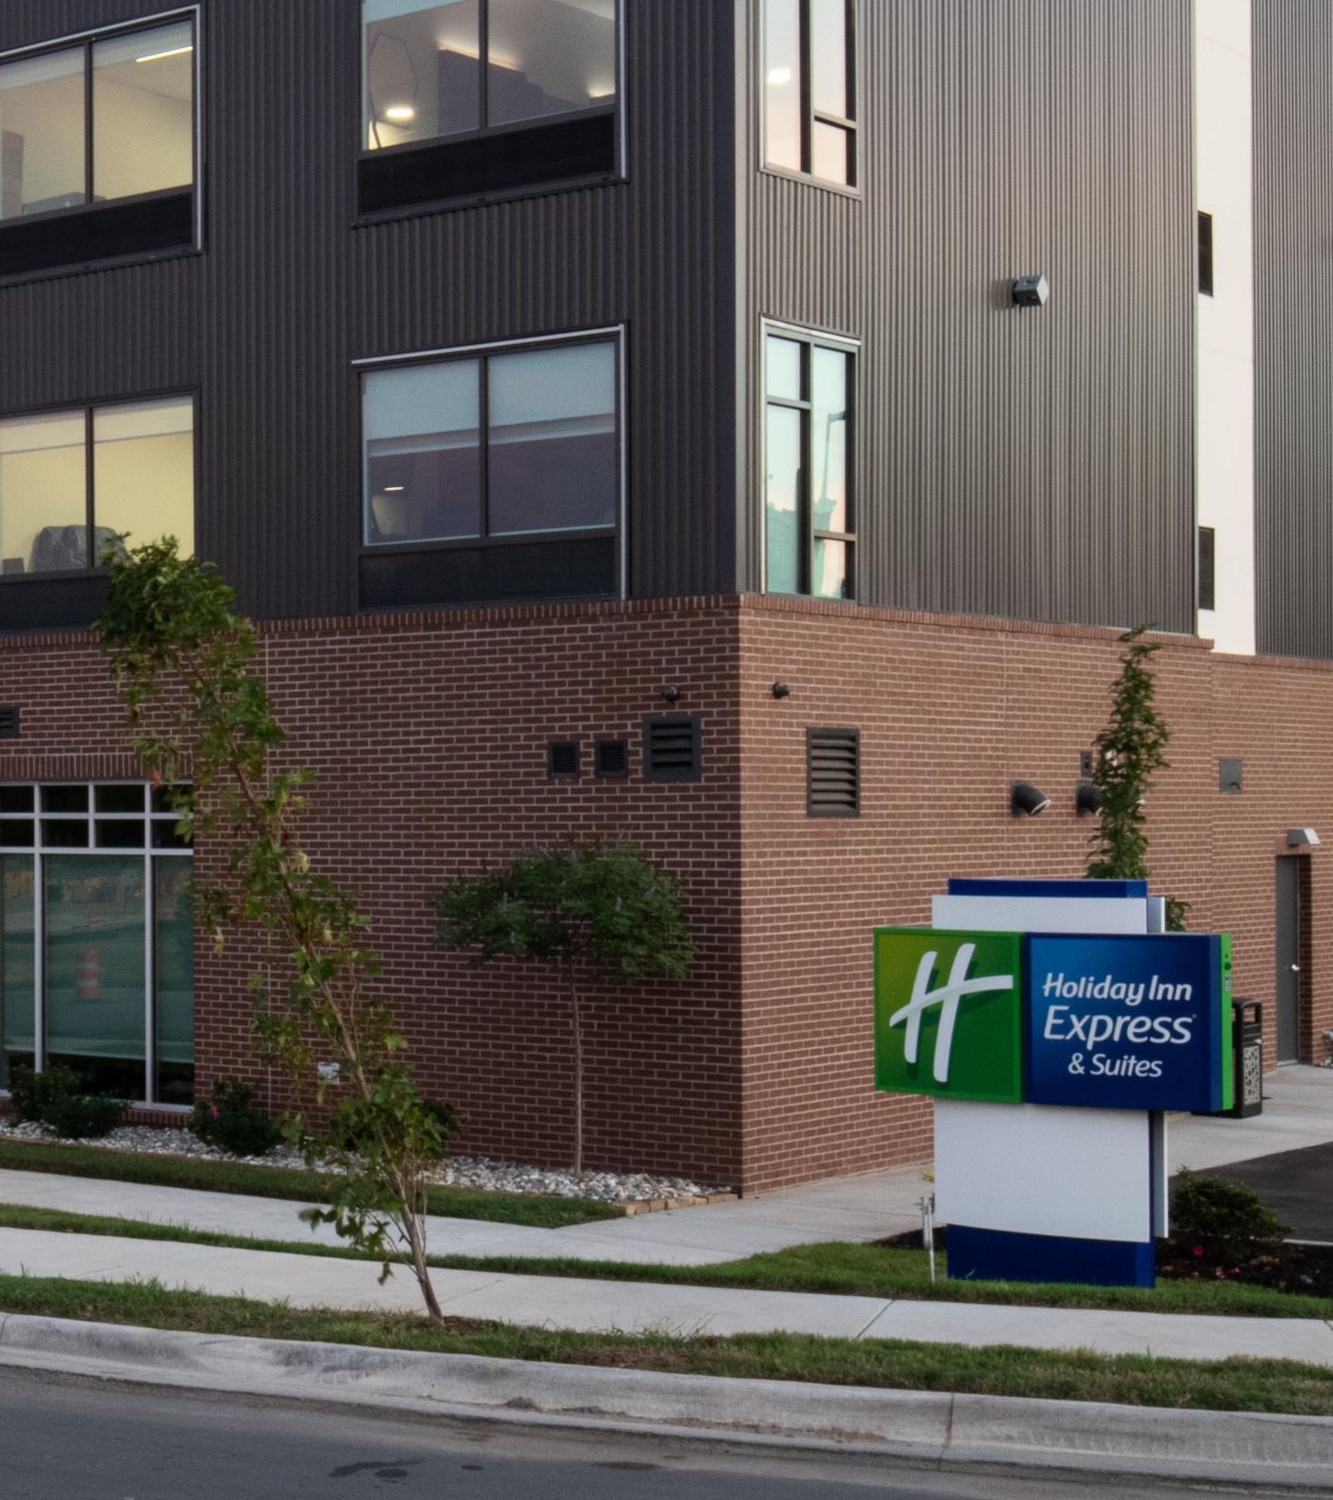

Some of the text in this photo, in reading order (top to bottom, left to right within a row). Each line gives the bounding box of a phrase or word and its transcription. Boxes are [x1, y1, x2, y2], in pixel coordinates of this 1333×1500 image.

[1041, 972, 1146, 1007] Holiday
[1148, 974, 1193, 1002] Inn
[1043, 1004, 1194, 1051] Express
[1067, 1052, 1164, 1078] & Suites
